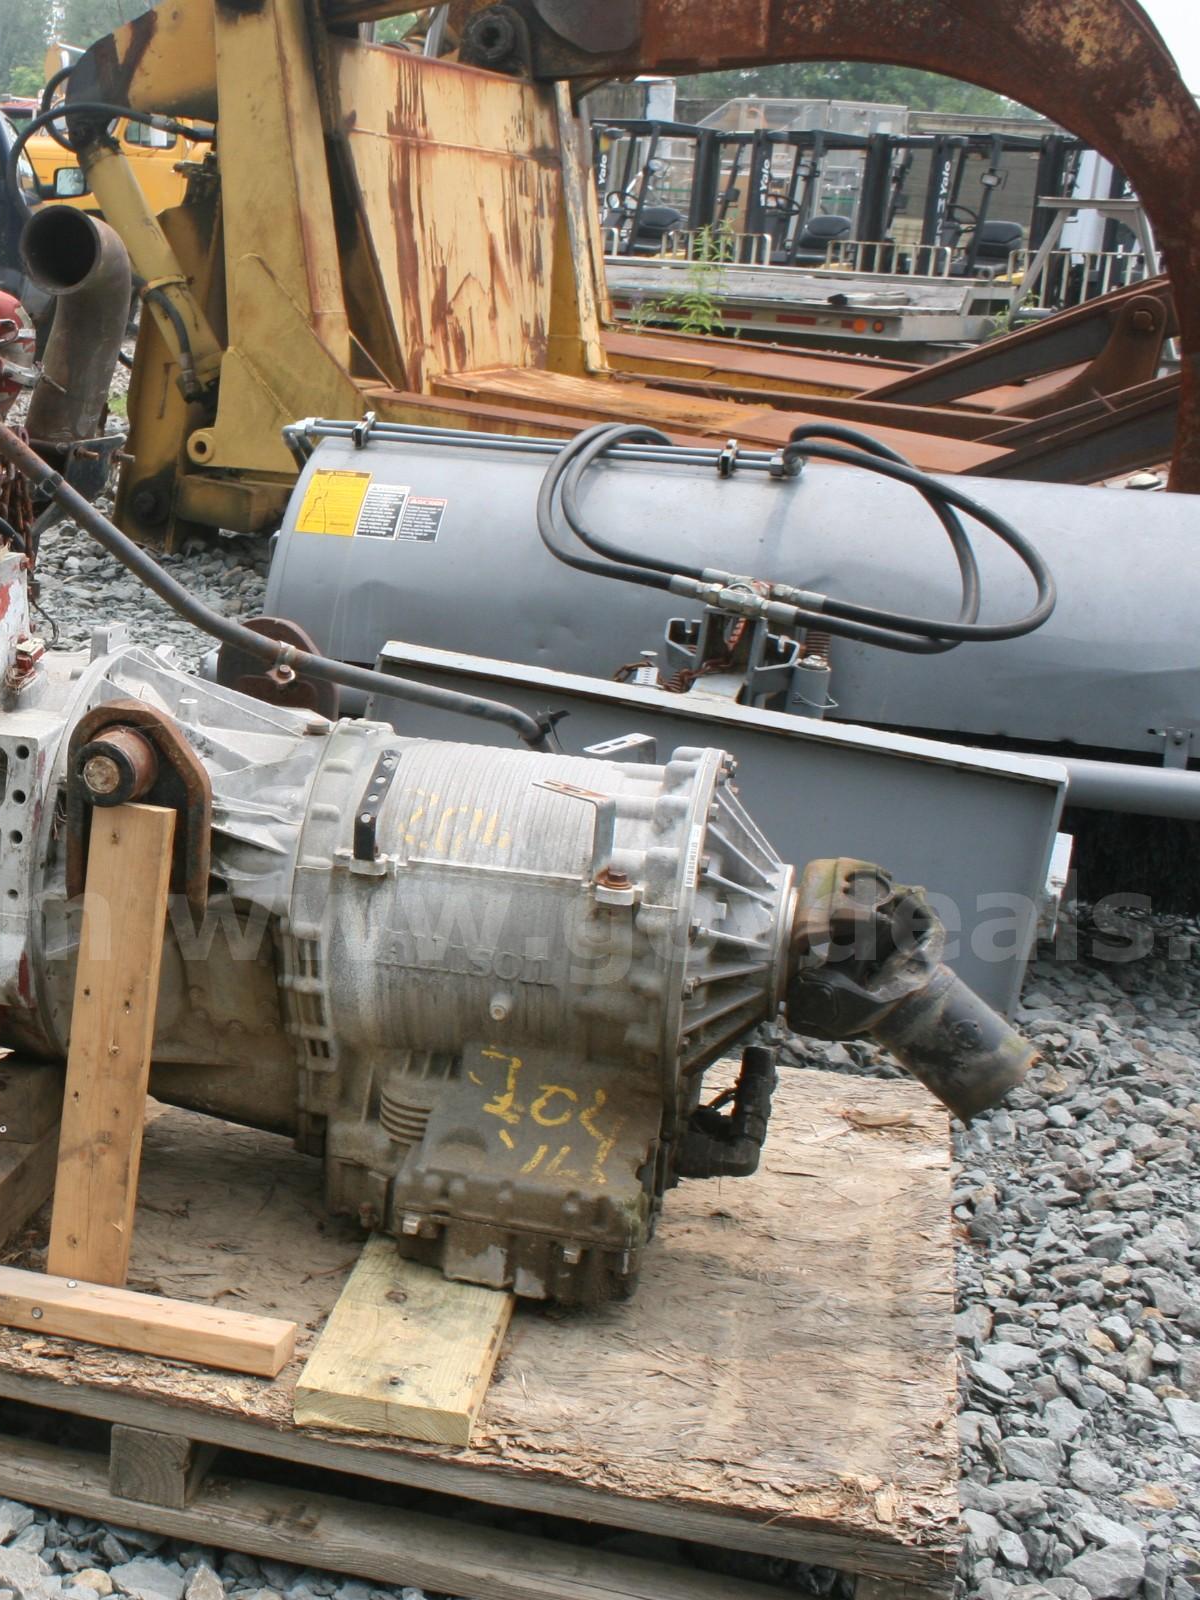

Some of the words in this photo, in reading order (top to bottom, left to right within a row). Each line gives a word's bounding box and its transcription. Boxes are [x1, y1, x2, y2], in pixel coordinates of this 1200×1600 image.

[760, 159, 770, 190] Yale
[940, 160, 951, 195] Yale
[376, 928, 557, 986] Ason
